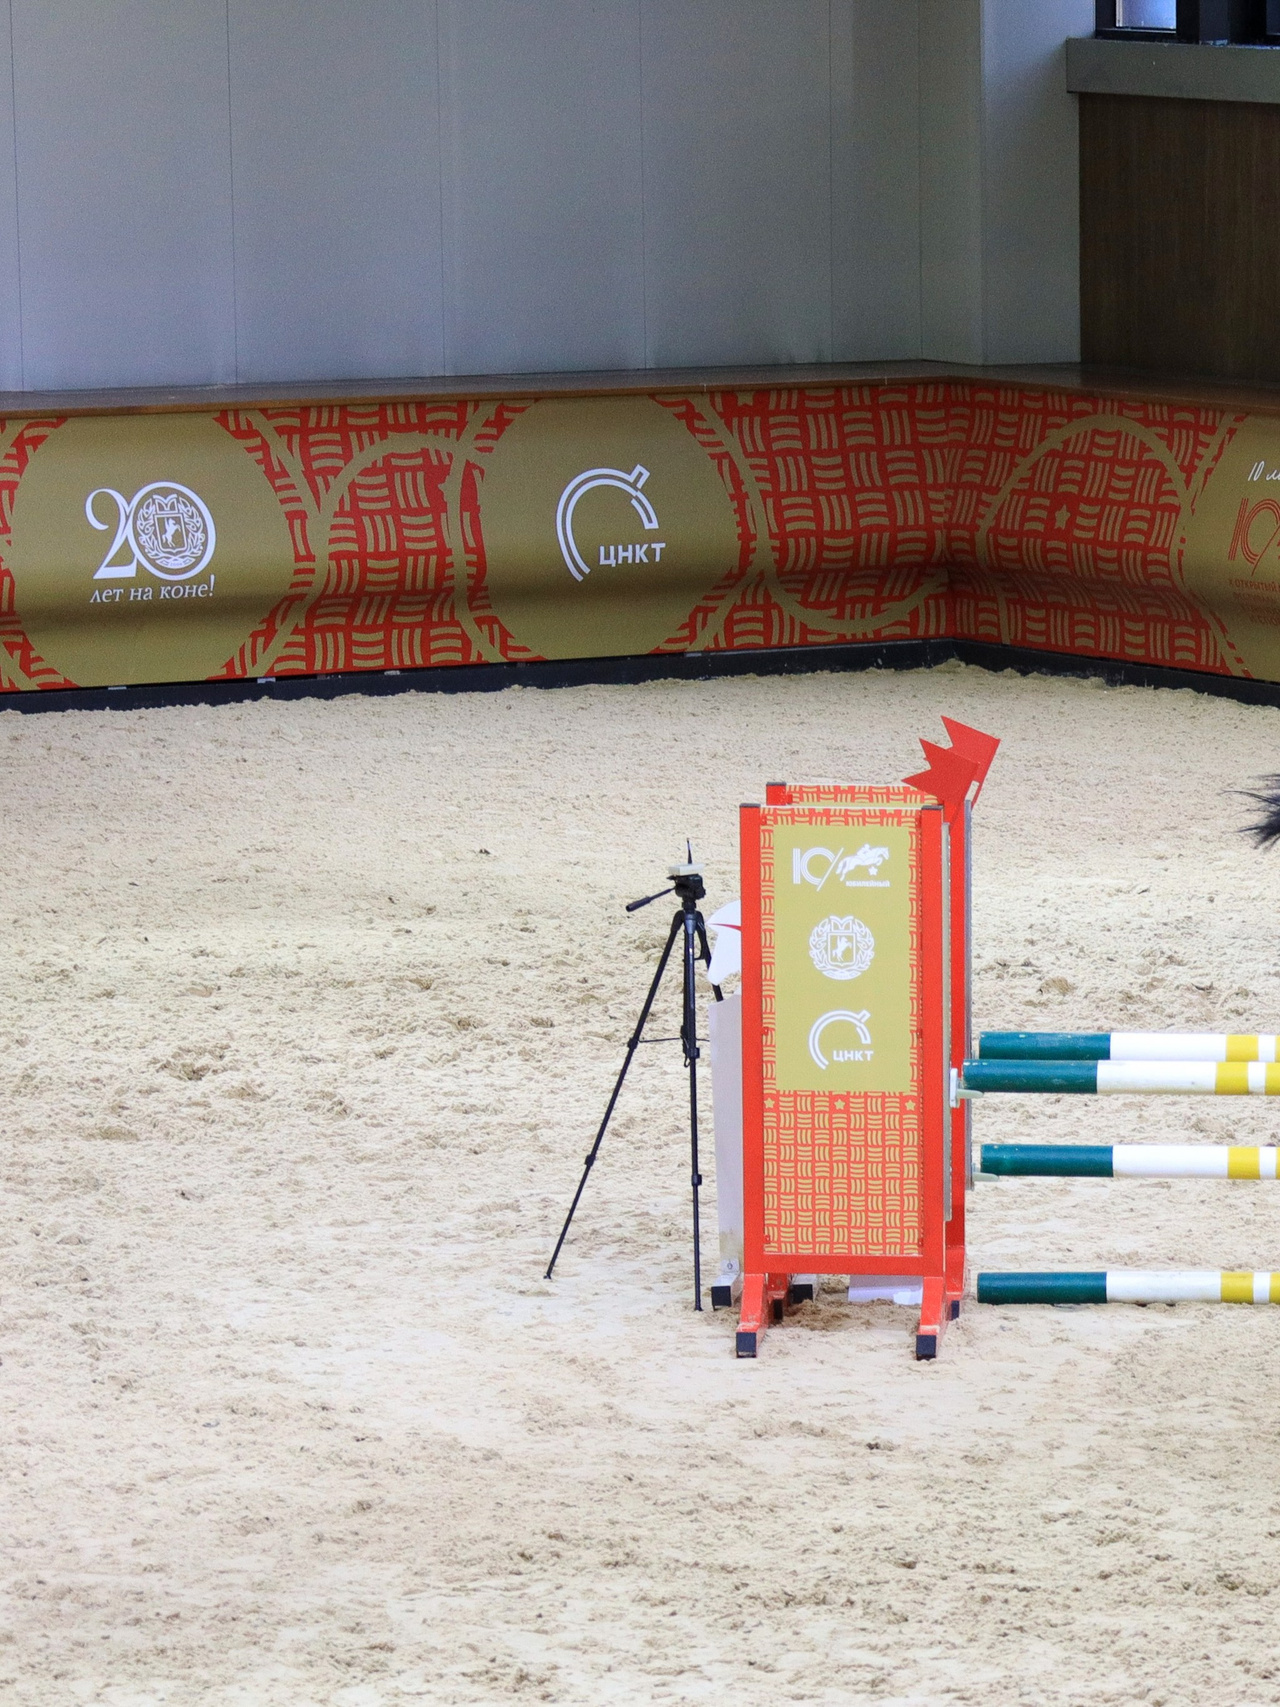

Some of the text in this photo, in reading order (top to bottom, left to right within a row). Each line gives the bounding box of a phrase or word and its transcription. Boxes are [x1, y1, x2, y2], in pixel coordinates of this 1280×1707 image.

[1248, 460, 1265, 482] 10
[85, 481, 217, 581] 20
[599, 542, 666, 567] ЦНКТ
[89, 574, 215, 603] лет на коне!
[1235, 578, 1277, 593] ОТКРЫТЫЙ
[832, 1050, 874, 1062] ЦНКТ
